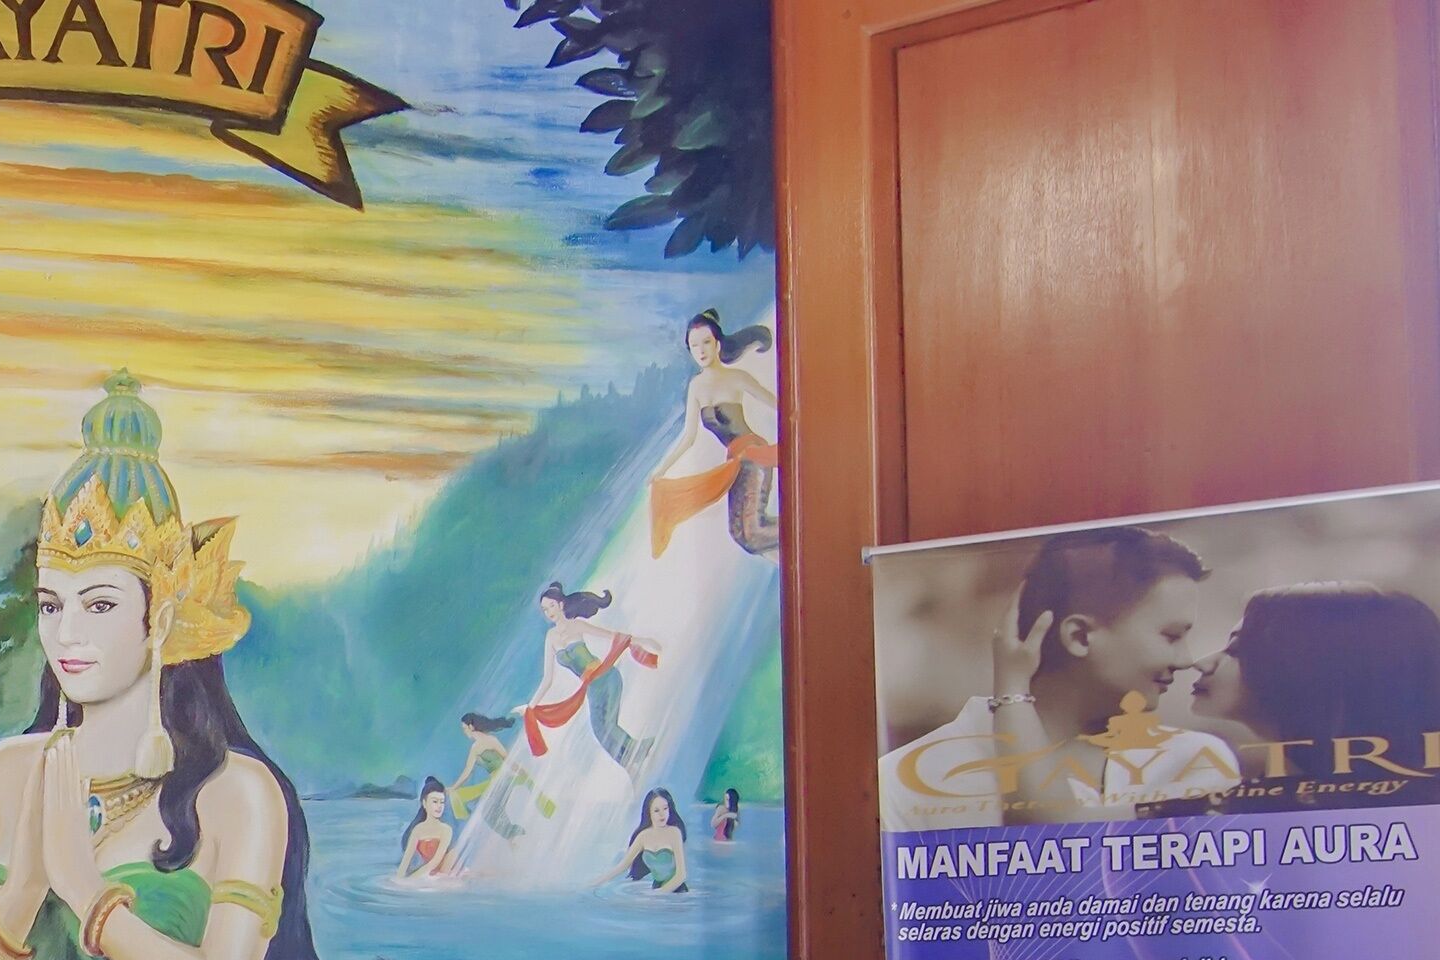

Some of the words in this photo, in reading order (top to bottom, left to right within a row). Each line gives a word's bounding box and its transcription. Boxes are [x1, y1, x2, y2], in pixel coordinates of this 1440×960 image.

[1295, 779, 1408, 795] Energy
[897, 840, 1089, 879] MANFAAT
[1102, 829, 1264, 871] TERAPI
[1280, 823, 1417, 865] AURA
[900, 902, 983, 921] Membuat
[982, 898, 1022, 922] jiwa
[1027, 897, 1073, 916] anda
[1078, 895, 1138, 915] damai
[1143, 894, 1179, 913] dan
[1185, 891, 1255, 915] tenang
[1259, 891, 1331, 910] karena
[1336, 887, 1404, 907] selalu
[898, 923, 963, 941] selaras
[967, 922, 1034, 944] dengan
[1039, 919, 1099, 942] energi
[1103, 916, 1169, 941] positif
[1172, 913, 1262, 935] semesta.
